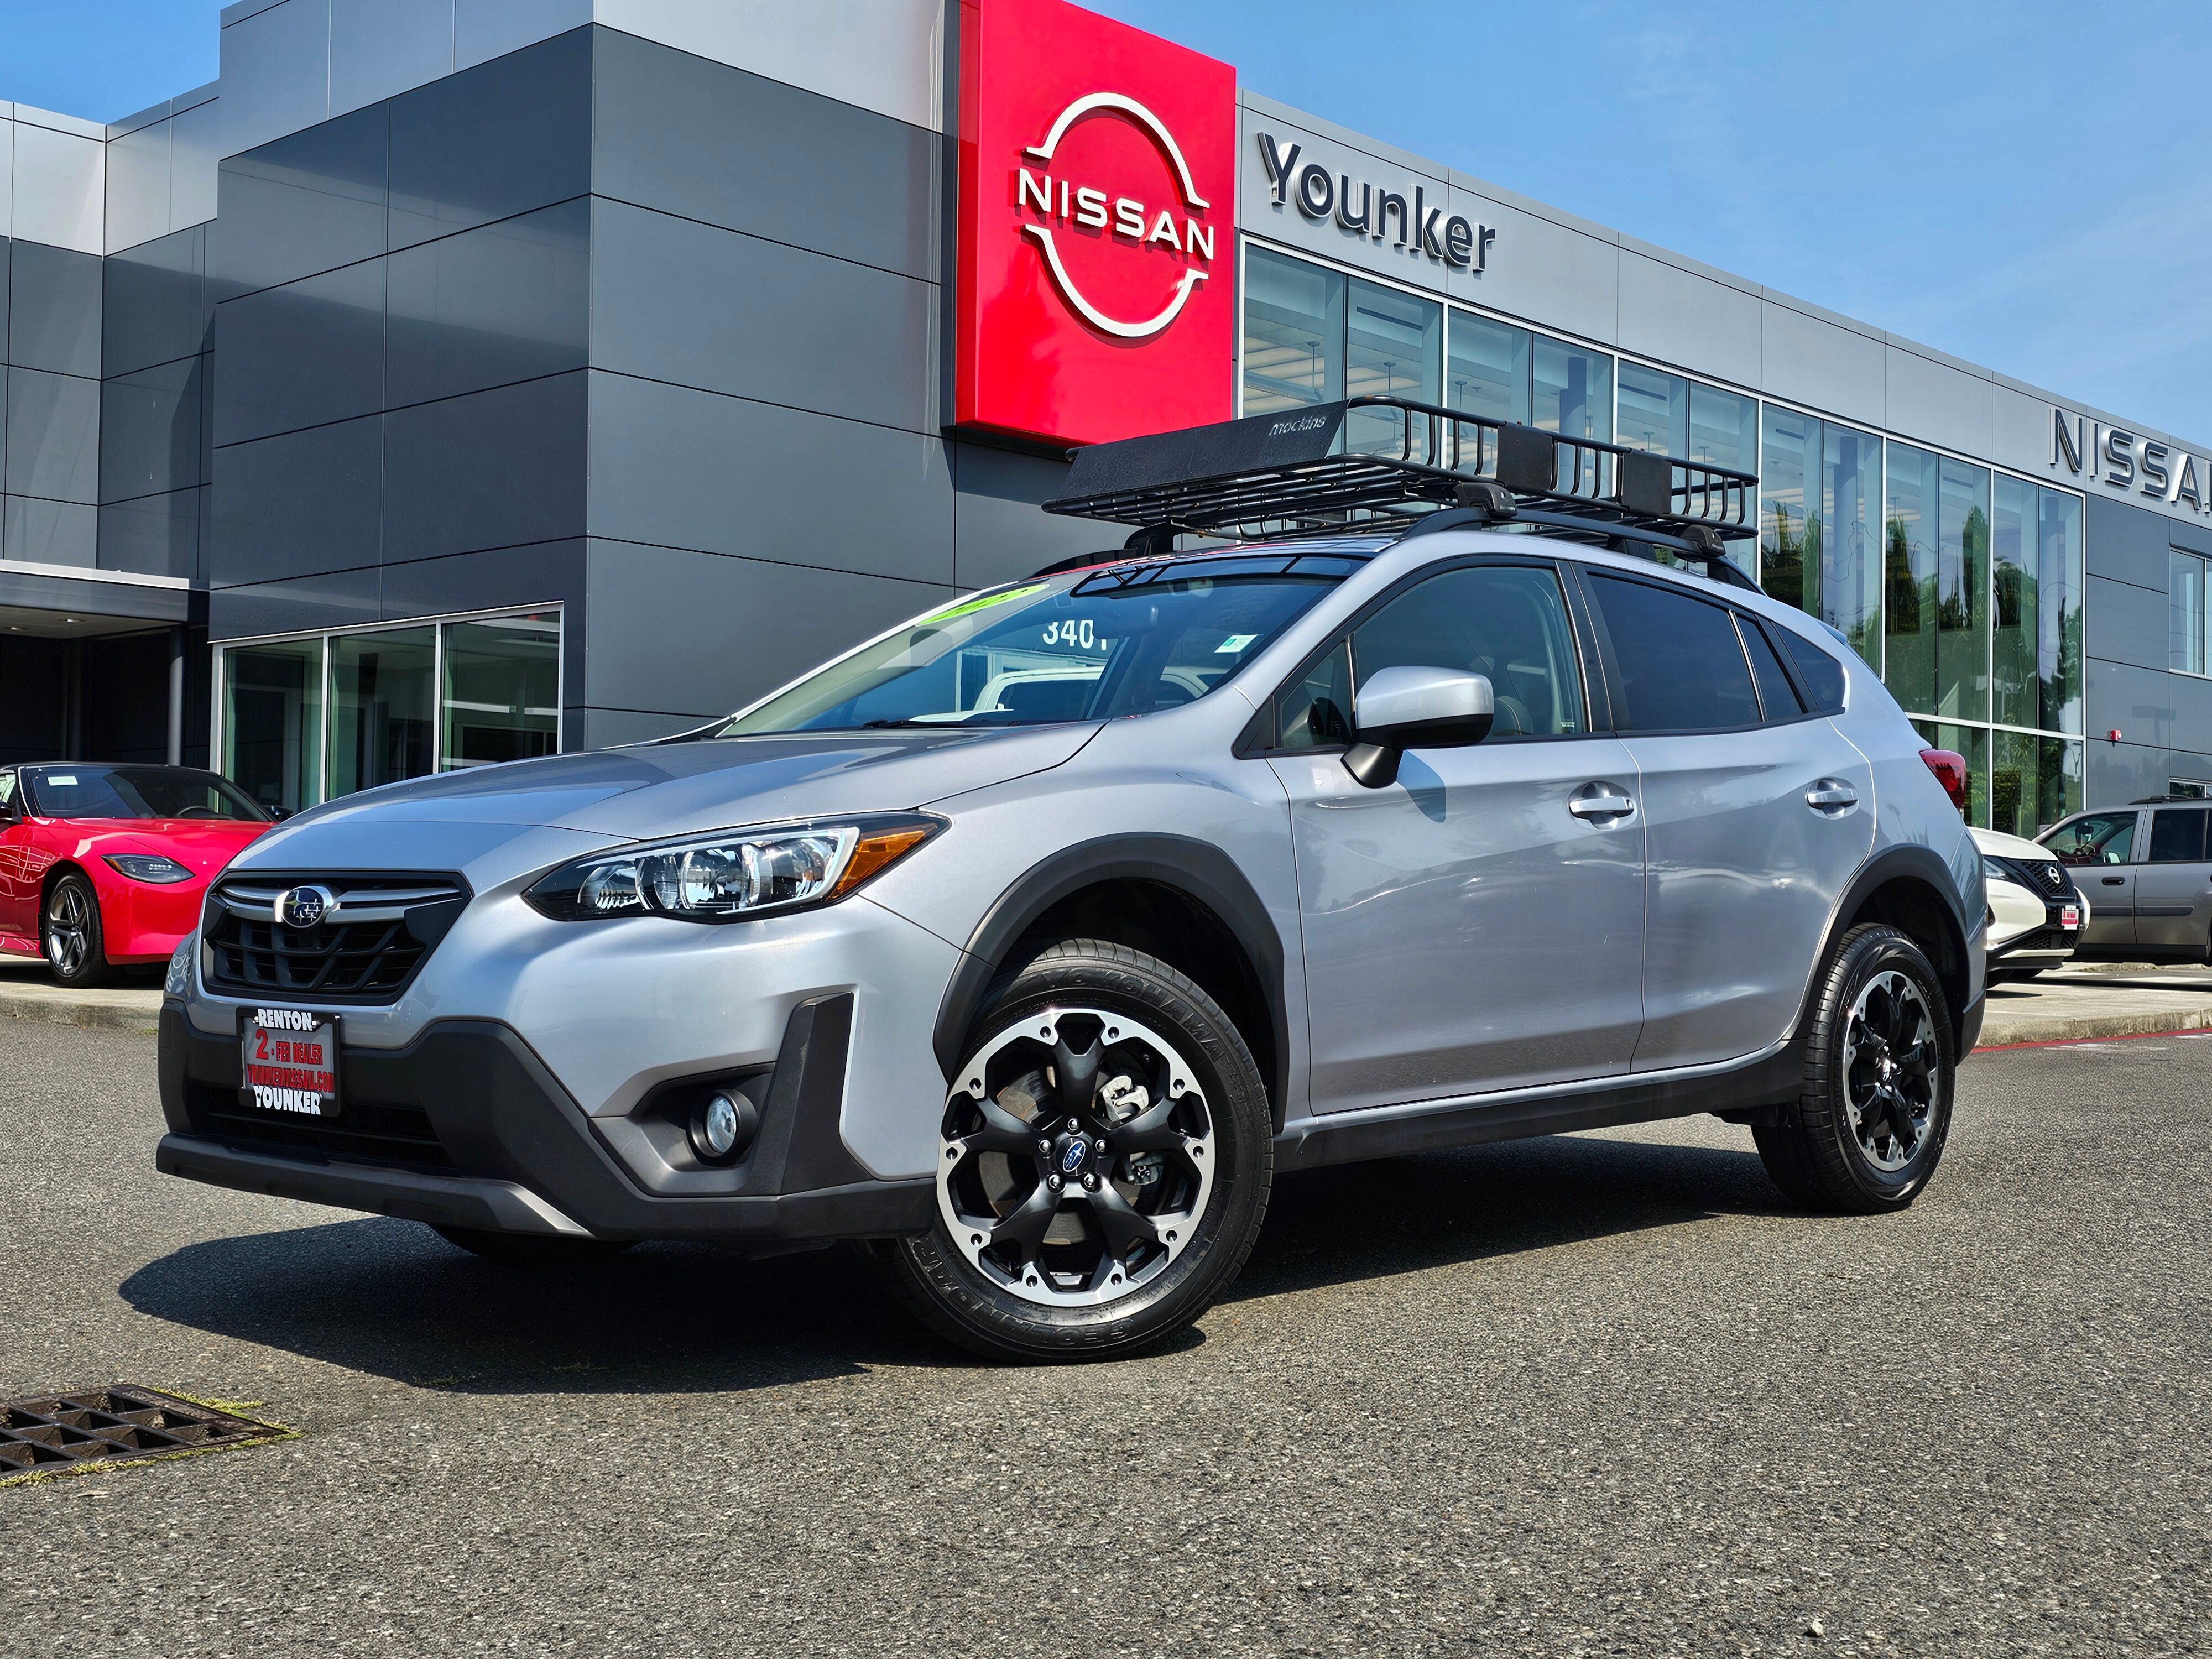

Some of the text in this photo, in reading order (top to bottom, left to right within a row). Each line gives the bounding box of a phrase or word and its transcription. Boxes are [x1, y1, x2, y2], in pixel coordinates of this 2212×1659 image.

[1015, 167, 1215, 262] NISSAN
[1257, 131, 1495, 272] Younker
[2049, 406, 2212, 513] NISSA
[258, 1009, 313, 1031] RENTON
[1042, 967, 1225, 1062] YOKOHAMA
[253, 1085, 322, 1115] YOUNKER
